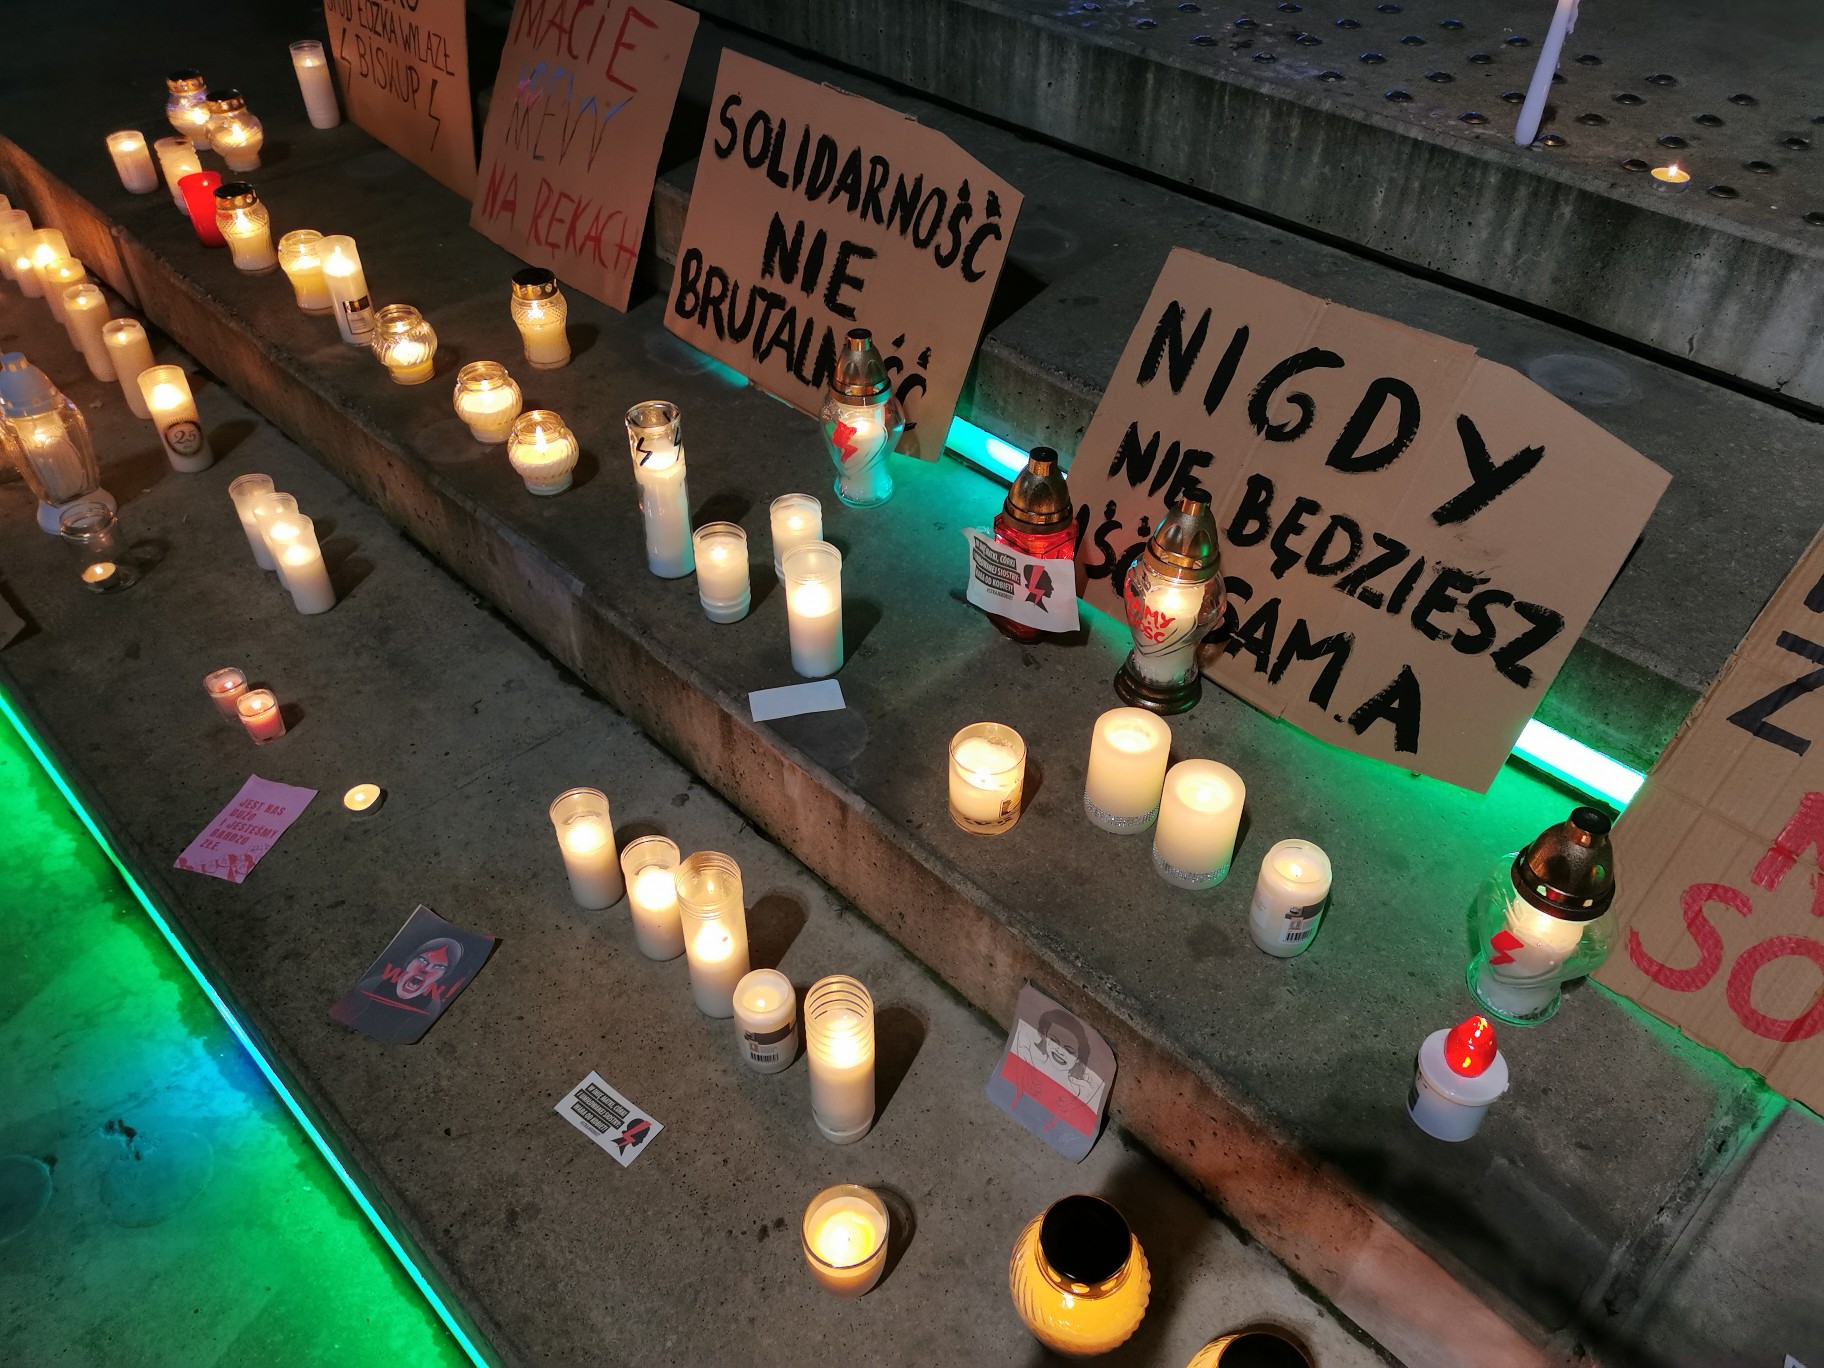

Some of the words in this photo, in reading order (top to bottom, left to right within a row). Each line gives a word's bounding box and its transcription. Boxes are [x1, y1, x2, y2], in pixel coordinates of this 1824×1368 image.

[482, 159, 518, 231] NA
[527, 177, 639, 279] RĘKACH
[714, 93, 1003, 283] SOLIDARNOŚĆ
[761, 212, 878, 321] NIE
[675, 248, 931, 432] BRUTALNĆ
[1137, 300, 1546, 526] NIGDY
[1108, 420, 1216, 511] NIE
[1226, 473, 1565, 689] BĘDZIESZ
[240, 798, 265, 811] JEST
[264, 803, 286, 816] NAS
